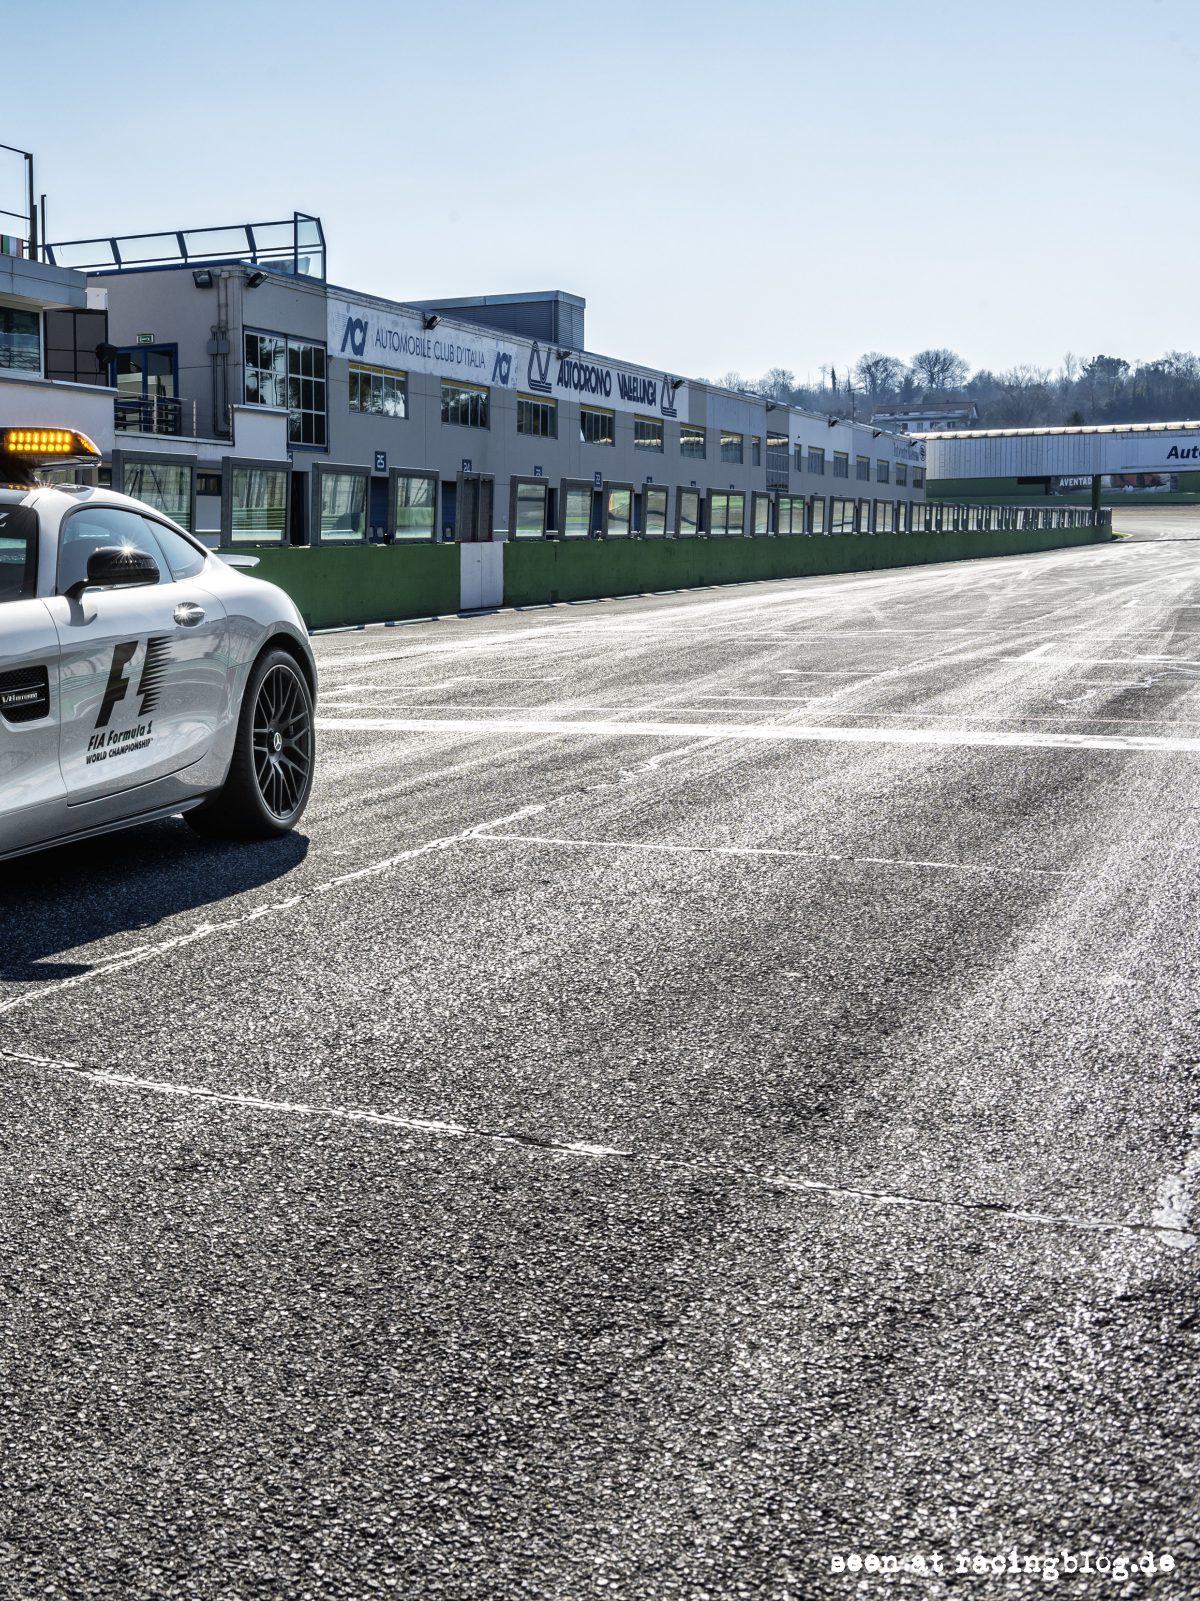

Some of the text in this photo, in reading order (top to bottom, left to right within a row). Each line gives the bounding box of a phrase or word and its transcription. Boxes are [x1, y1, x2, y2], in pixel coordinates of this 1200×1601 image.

[375, 328, 486, 369] AUTOMOBILE CLUB D'ITALIA
[557, 359, 612, 398] AUTODROMO
[86, 739, 151, 765] WORLD CHAMPIONSHIP
[88, 720, 153, 752] FIA Formula 1
